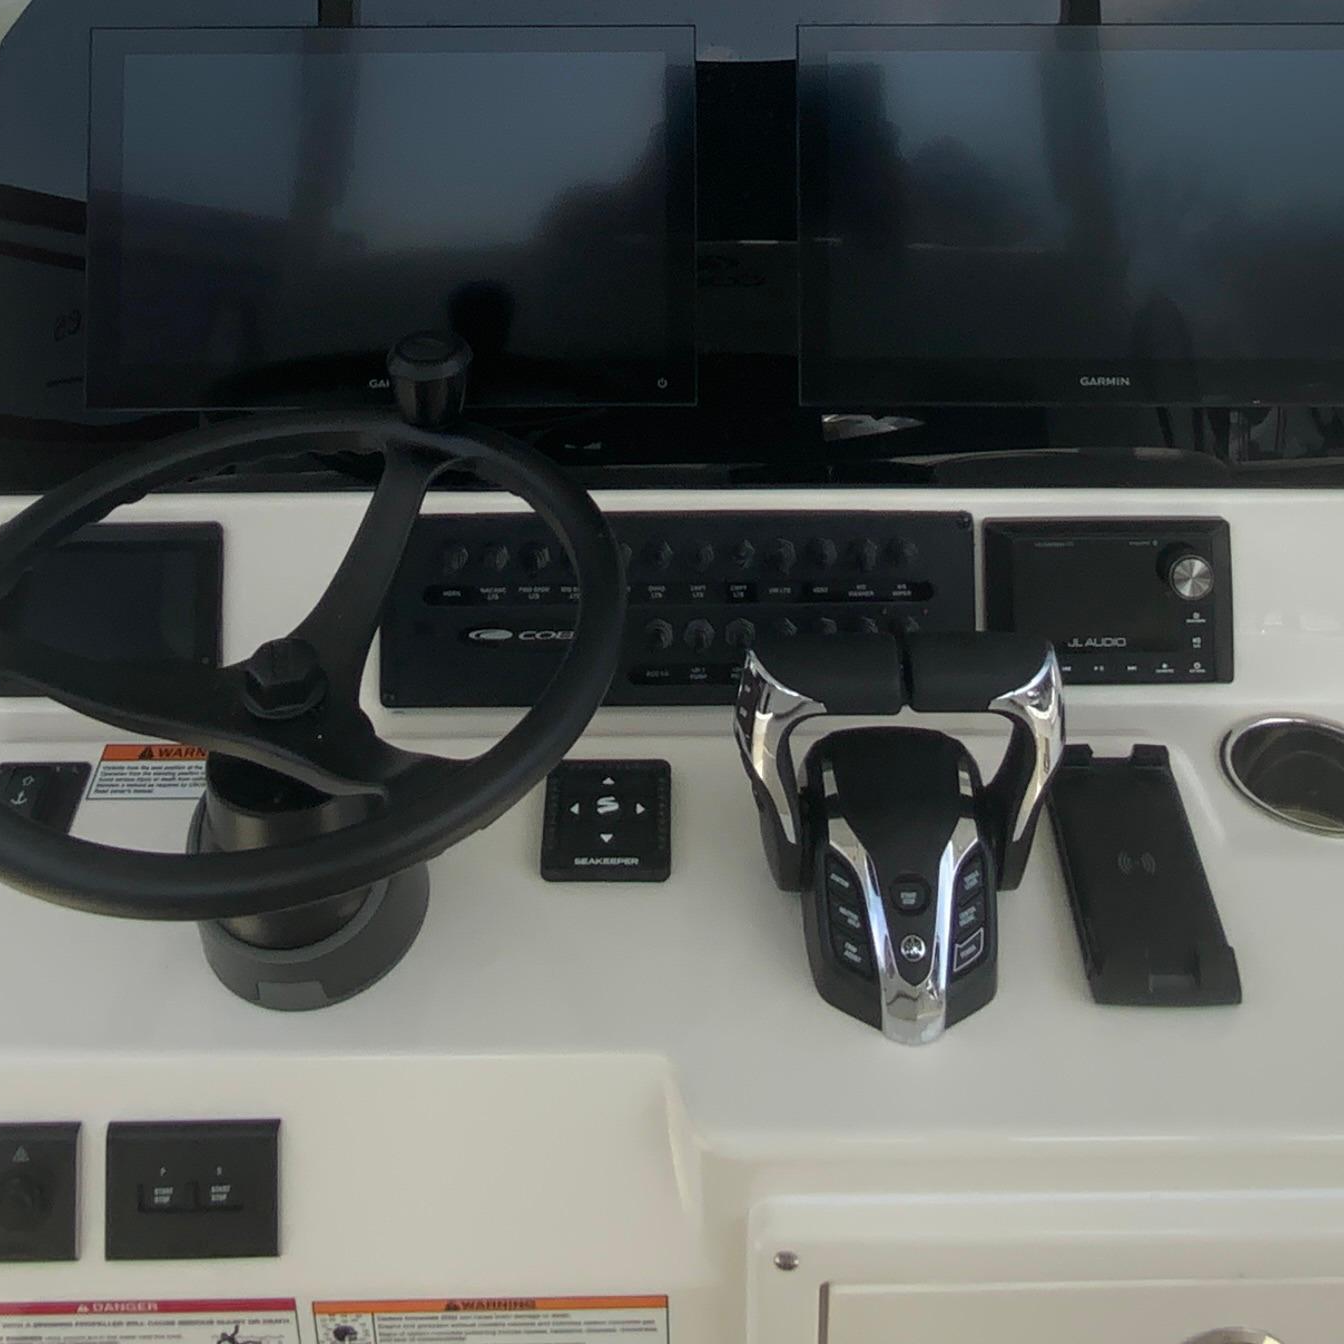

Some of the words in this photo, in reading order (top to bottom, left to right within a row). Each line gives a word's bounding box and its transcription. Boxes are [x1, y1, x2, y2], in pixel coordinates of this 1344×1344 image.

[1080, 376, 1131, 386] GARMIN
[1067, 637, 1083, 647] JL
[1084, 637, 1127, 647] AUDIO
[574, 857, 640, 865] SEAKEEPER
[93, 1302, 159, 1312] DANGER
